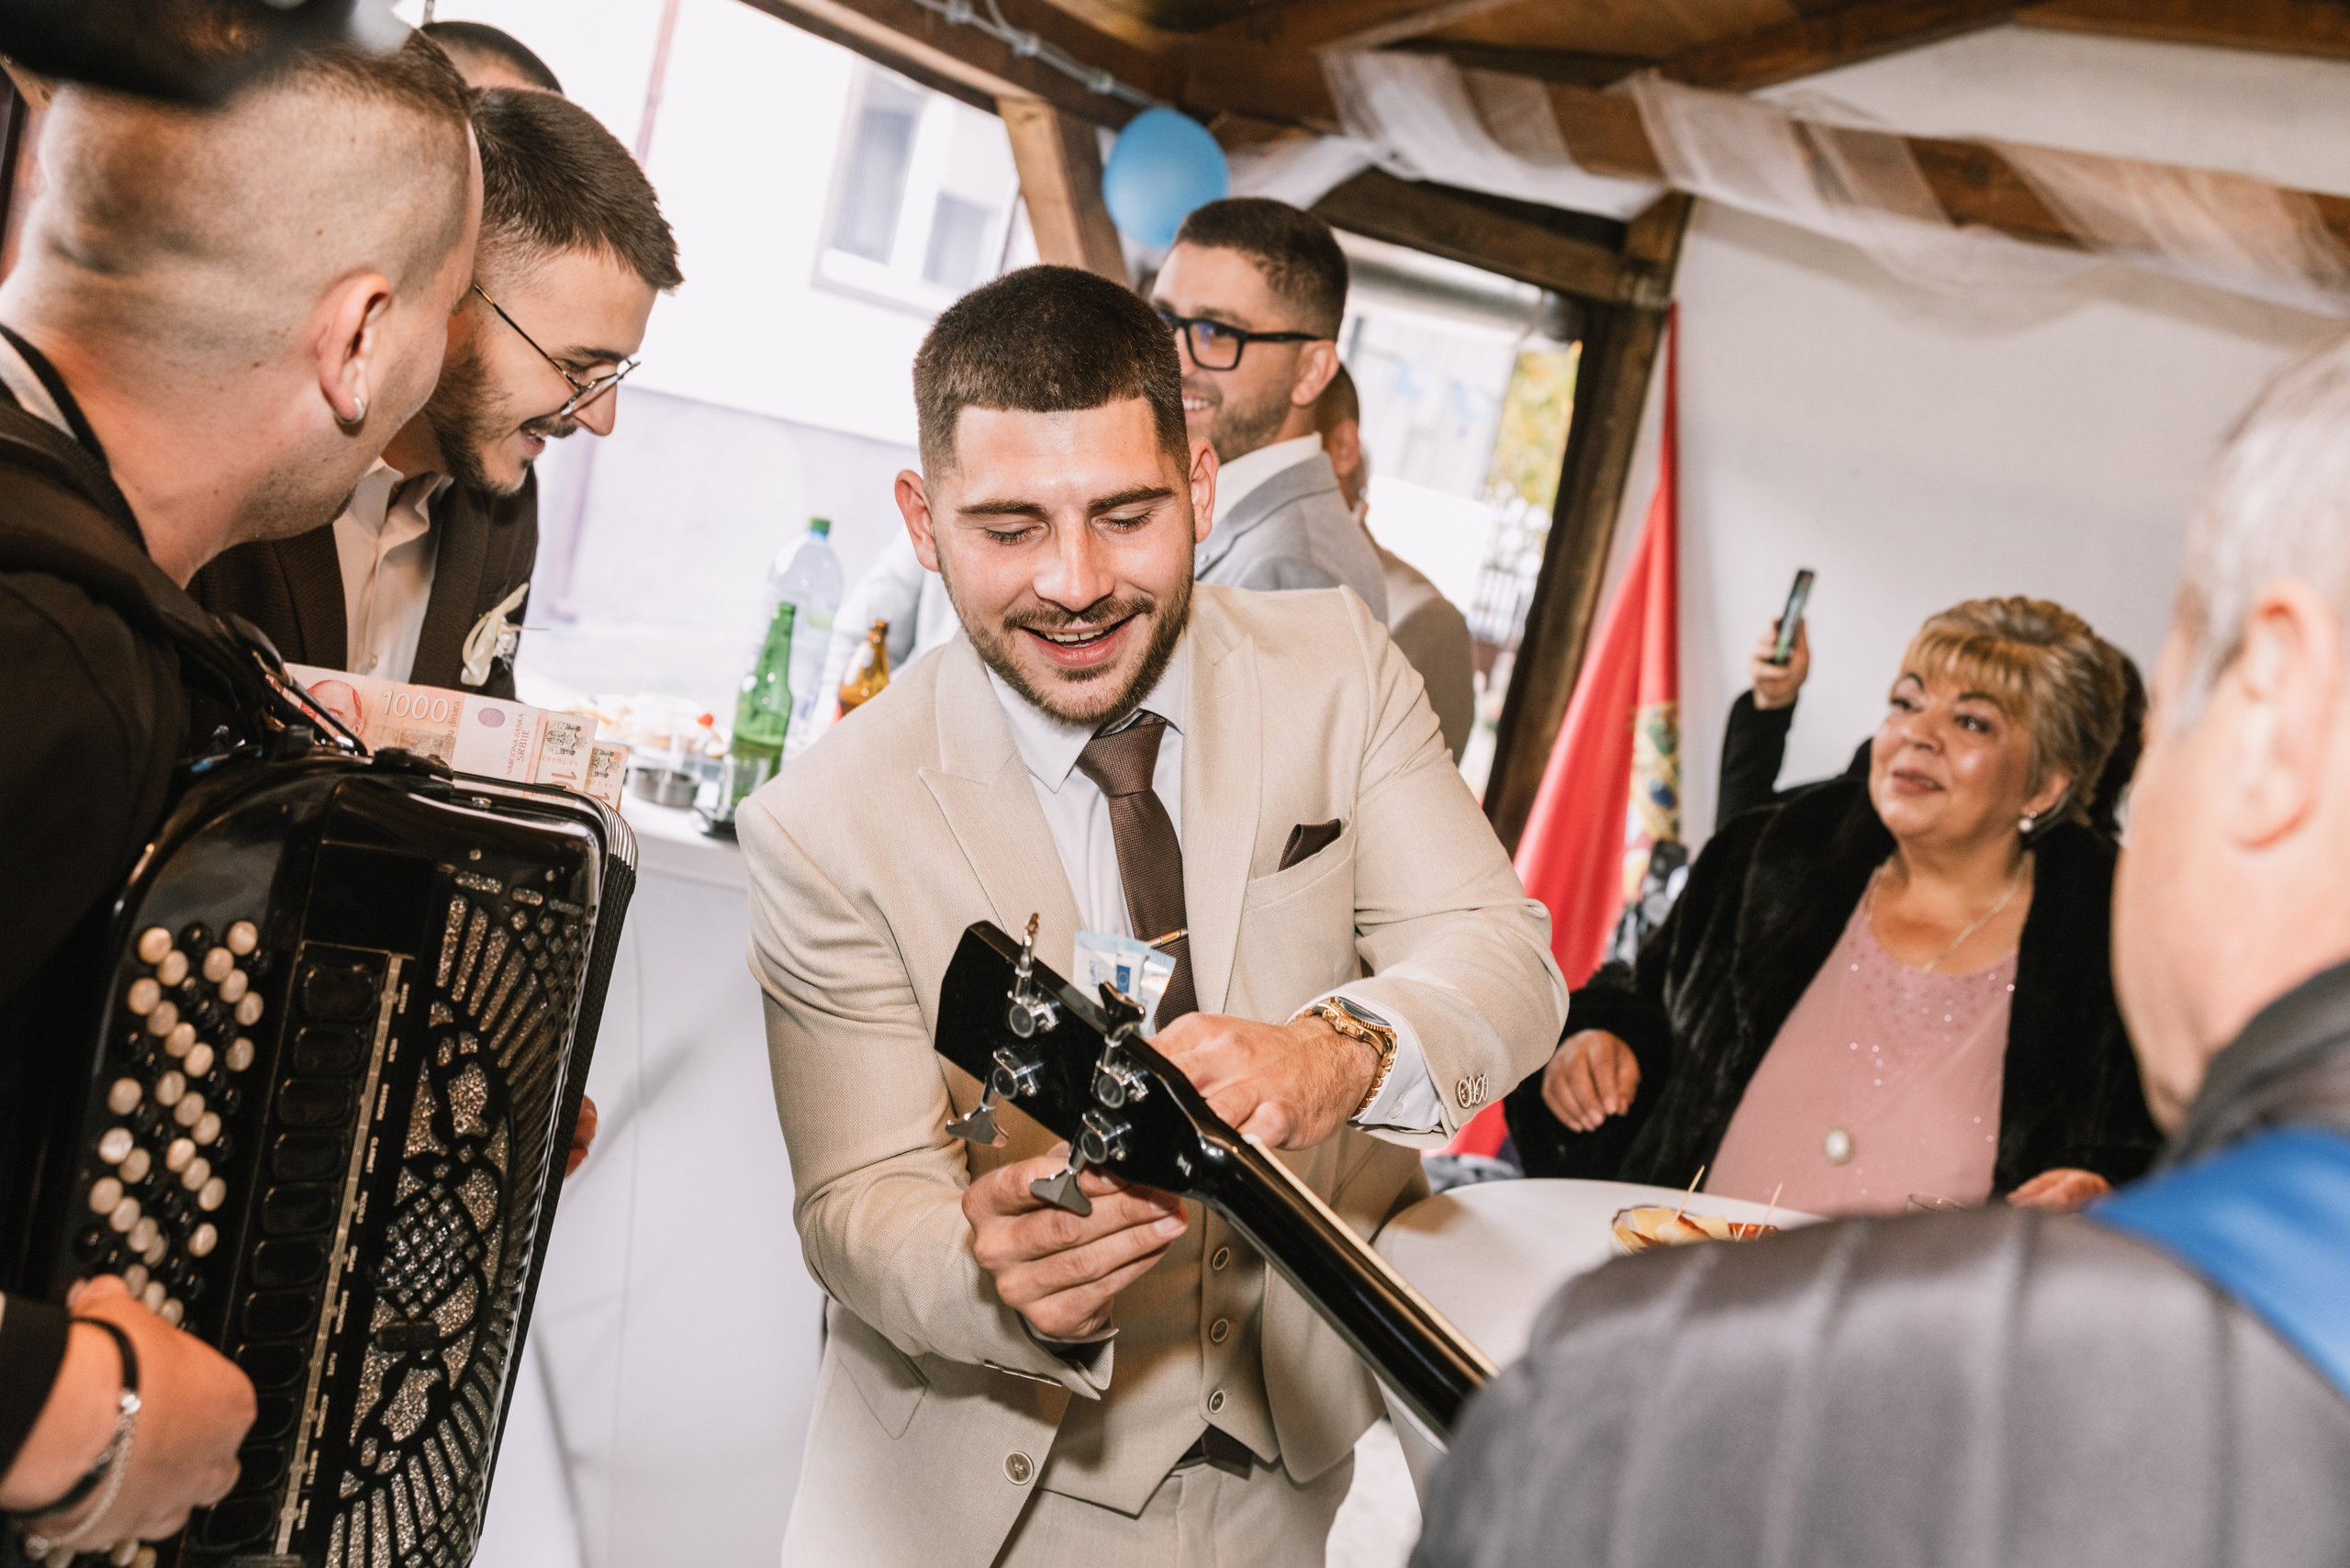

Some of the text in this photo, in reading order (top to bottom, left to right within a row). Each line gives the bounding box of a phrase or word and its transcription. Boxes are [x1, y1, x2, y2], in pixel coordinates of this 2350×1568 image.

[383, 690, 449, 723] 1000
[448, 700, 461, 728] dinara
[507, 713, 524, 775] NARODNA BANKA
[516, 730, 530, 762] SRBIJE
[387, 1037, 398, 1062] VIOLIN
[375, 1083, 389, 1121] BASSOON
[365, 1137, 379, 1173] CLARINET
[355, 1191, 368, 1225] PICCOLO
[346, 1245, 358, 1272] ORGAN
